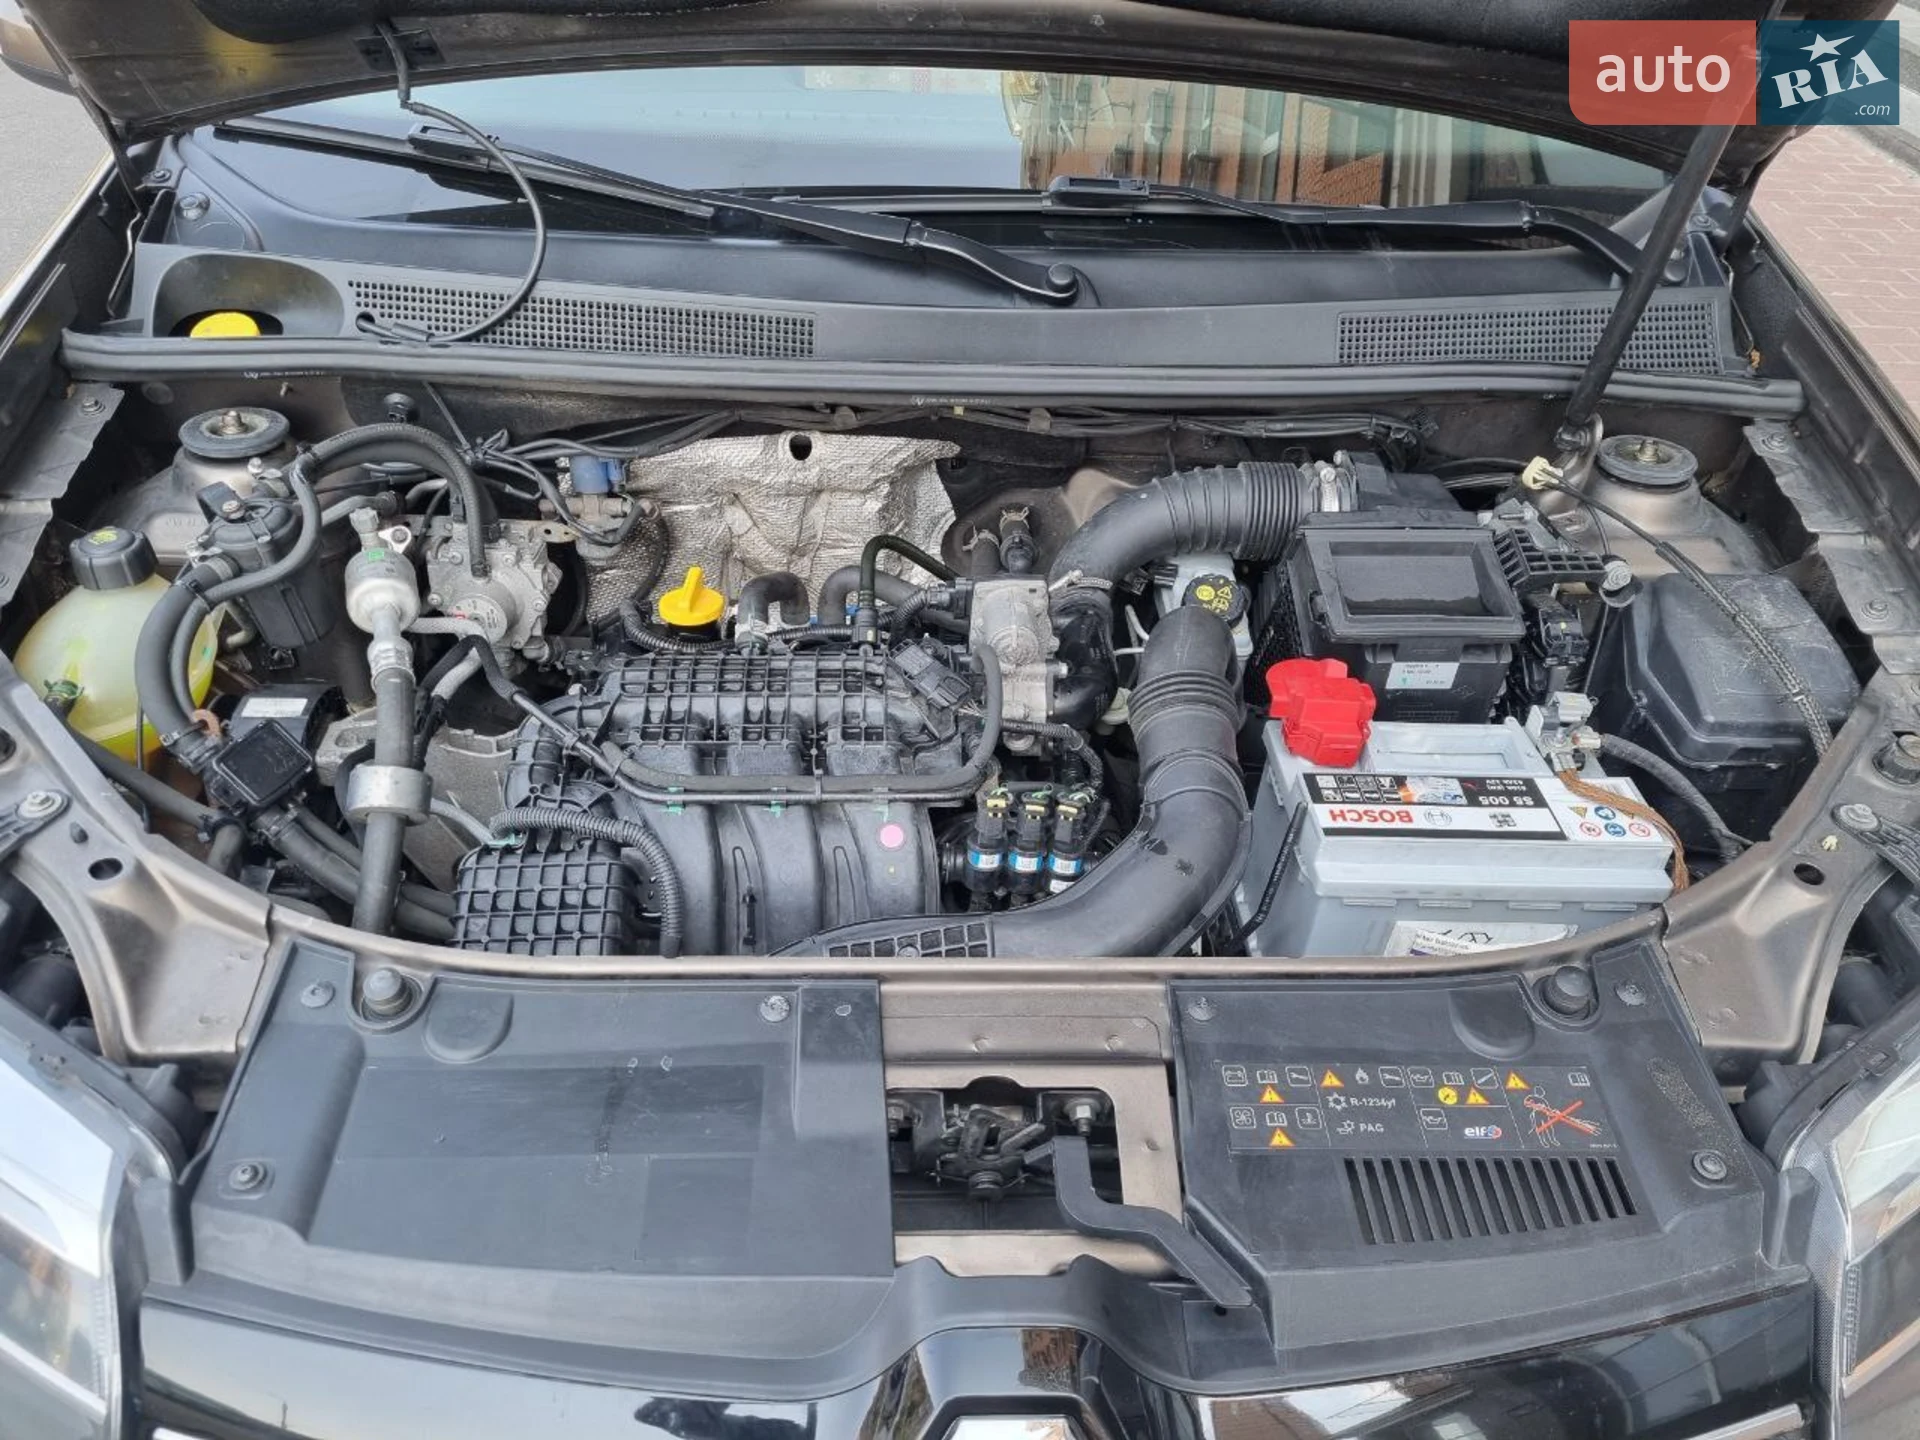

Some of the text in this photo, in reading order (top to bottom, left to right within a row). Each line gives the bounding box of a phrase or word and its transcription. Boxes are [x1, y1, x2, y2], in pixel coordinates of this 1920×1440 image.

[1478, 796, 1510, 806] 005
[1329, 808, 1413, 824] BOSCH
[1350, 1096, 1397, 1110] R-1234yf
[1360, 1123, 1385, 1134] PAG
[1464, 1126, 1488, 1138] elf
